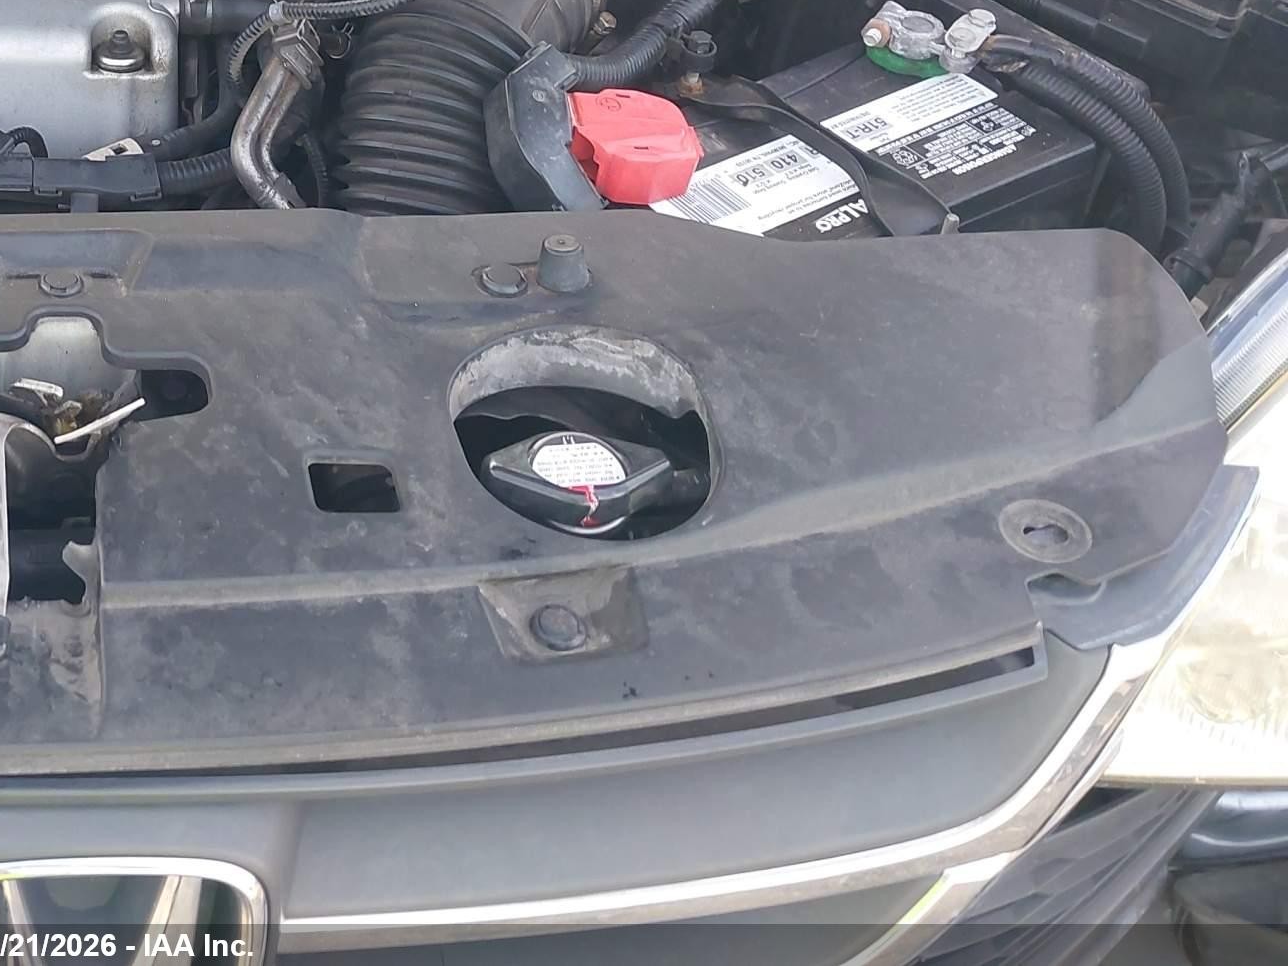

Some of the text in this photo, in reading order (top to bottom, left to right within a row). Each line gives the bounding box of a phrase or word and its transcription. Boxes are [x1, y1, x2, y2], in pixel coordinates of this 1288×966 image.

[848, 117, 888, 139] 51R-T
[769, 154, 799, 170] 410
[737, 167, 767, 185] 510
